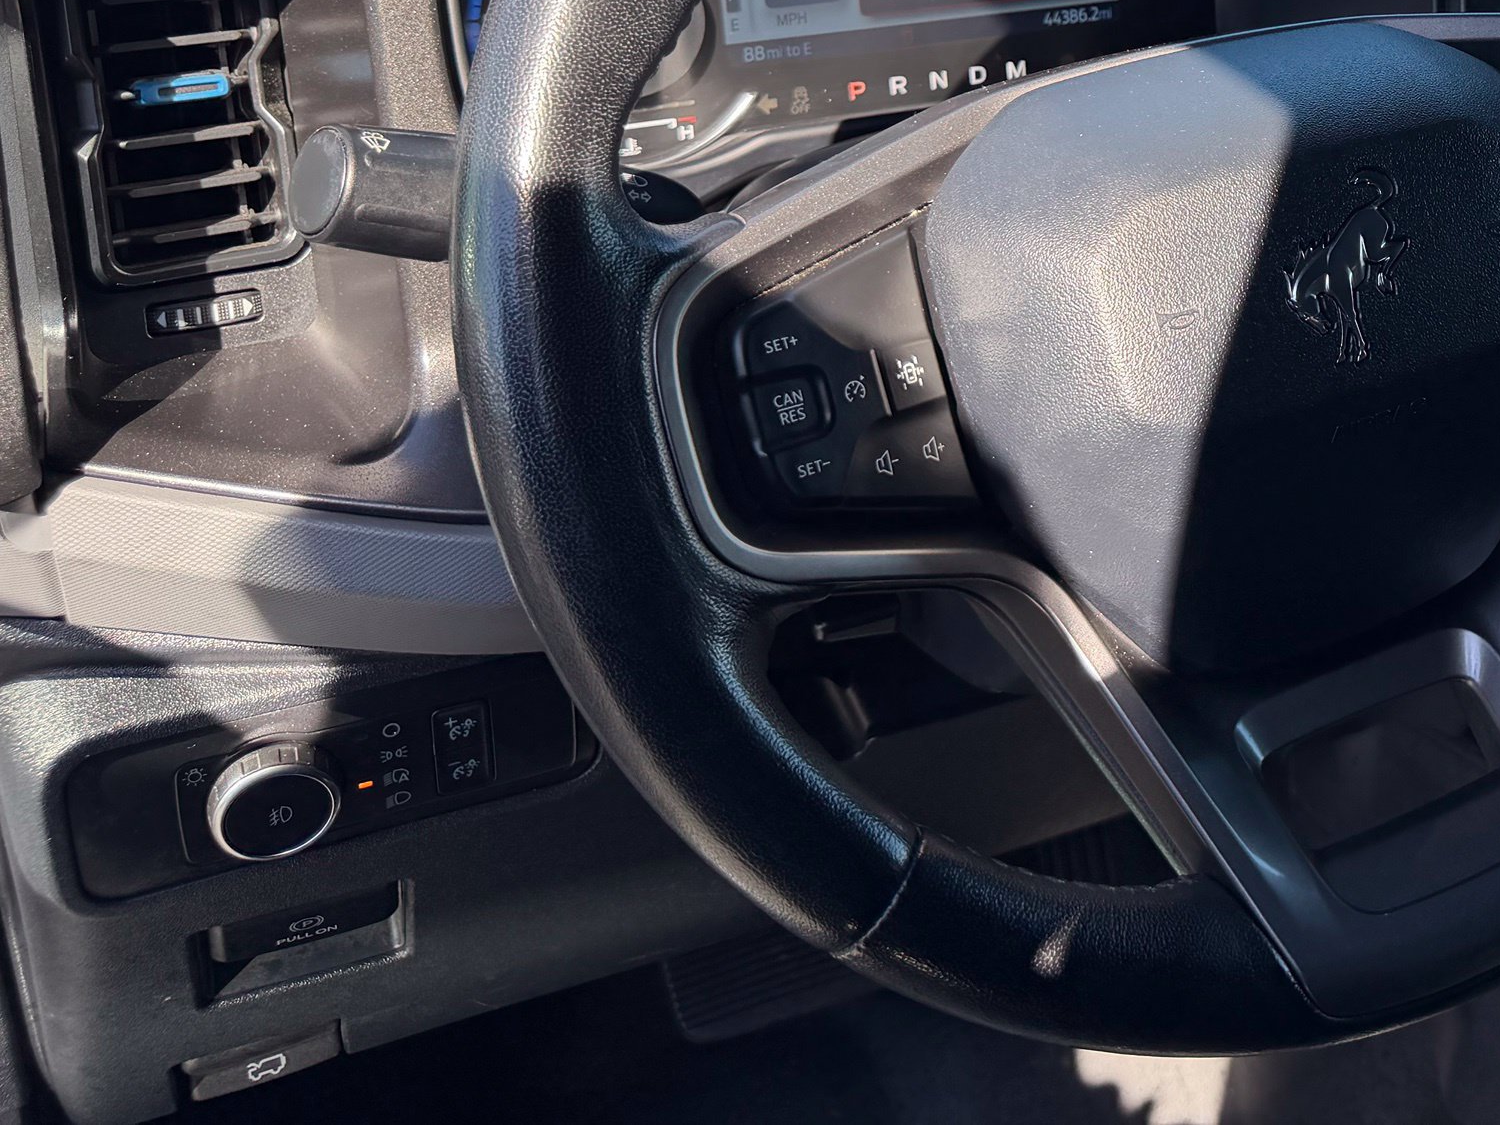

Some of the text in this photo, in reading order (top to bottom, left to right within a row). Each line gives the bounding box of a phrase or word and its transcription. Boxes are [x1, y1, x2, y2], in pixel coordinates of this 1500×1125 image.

[731, 18, 739, 32] E
[776, 11, 808, 27] MPH
[786, 44, 800, 56] to
[804, 42, 813, 55] E
[848, 60, 1027, 101] P R N D M
[677, 124, 695, 141] H
[764, 336, 799, 354] SET+
[773, 389, 804, 408] CAN
[779, 408, 807, 426] RES
[797, 459, 831, 478] SET-
[276, 924, 338, 946] PULL ON
